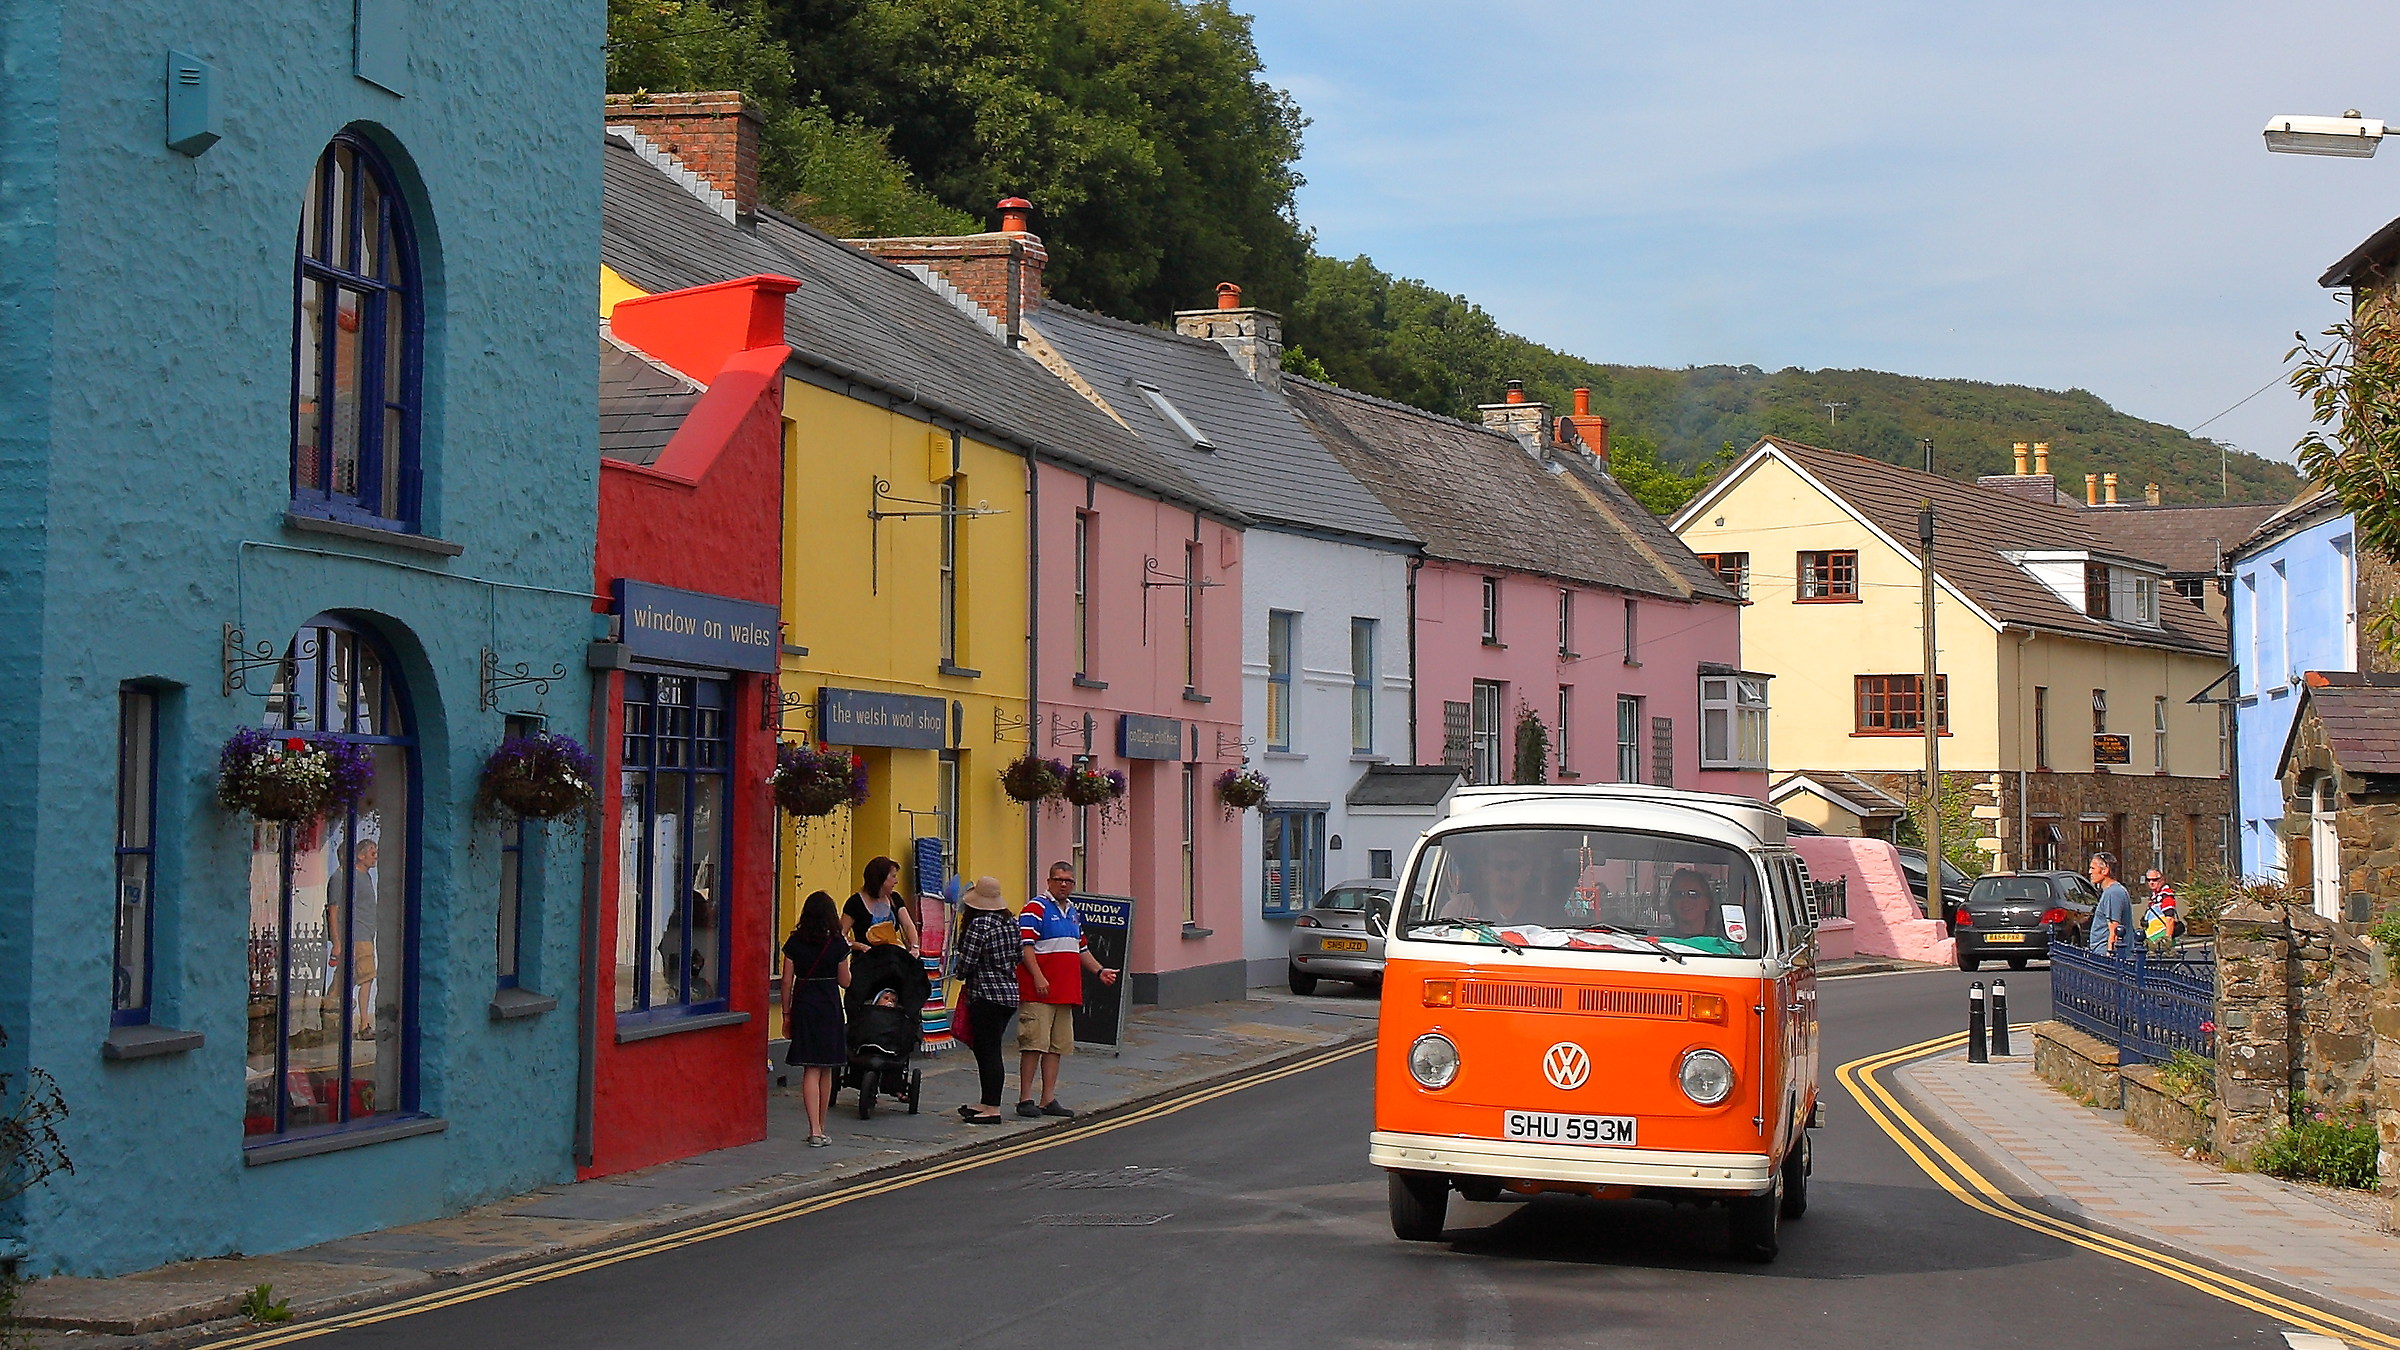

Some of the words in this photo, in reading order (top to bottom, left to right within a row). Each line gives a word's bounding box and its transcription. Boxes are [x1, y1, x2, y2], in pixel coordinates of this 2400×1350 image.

[634, 604, 697, 635] window
[703, 620, 722, 640] on
[730, 622, 770, 647] wales
[833, 702, 851, 723] the
[856, 706, 888, 726] welsh
[892, 712, 914, 728] wool
[918, 710, 941, 733] shop
[1130, 729, 1153, 747] cottage
[1154, 730, 1177, 745] clothes
[1073, 902, 1121, 914] WINDOW
[1084, 913, 1125, 926] WALES
[1542, 1041, 1591, 1090] VW
[1511, 1114, 1559, 1138] SHU
[1567, 1117, 1633, 1142] 593M
